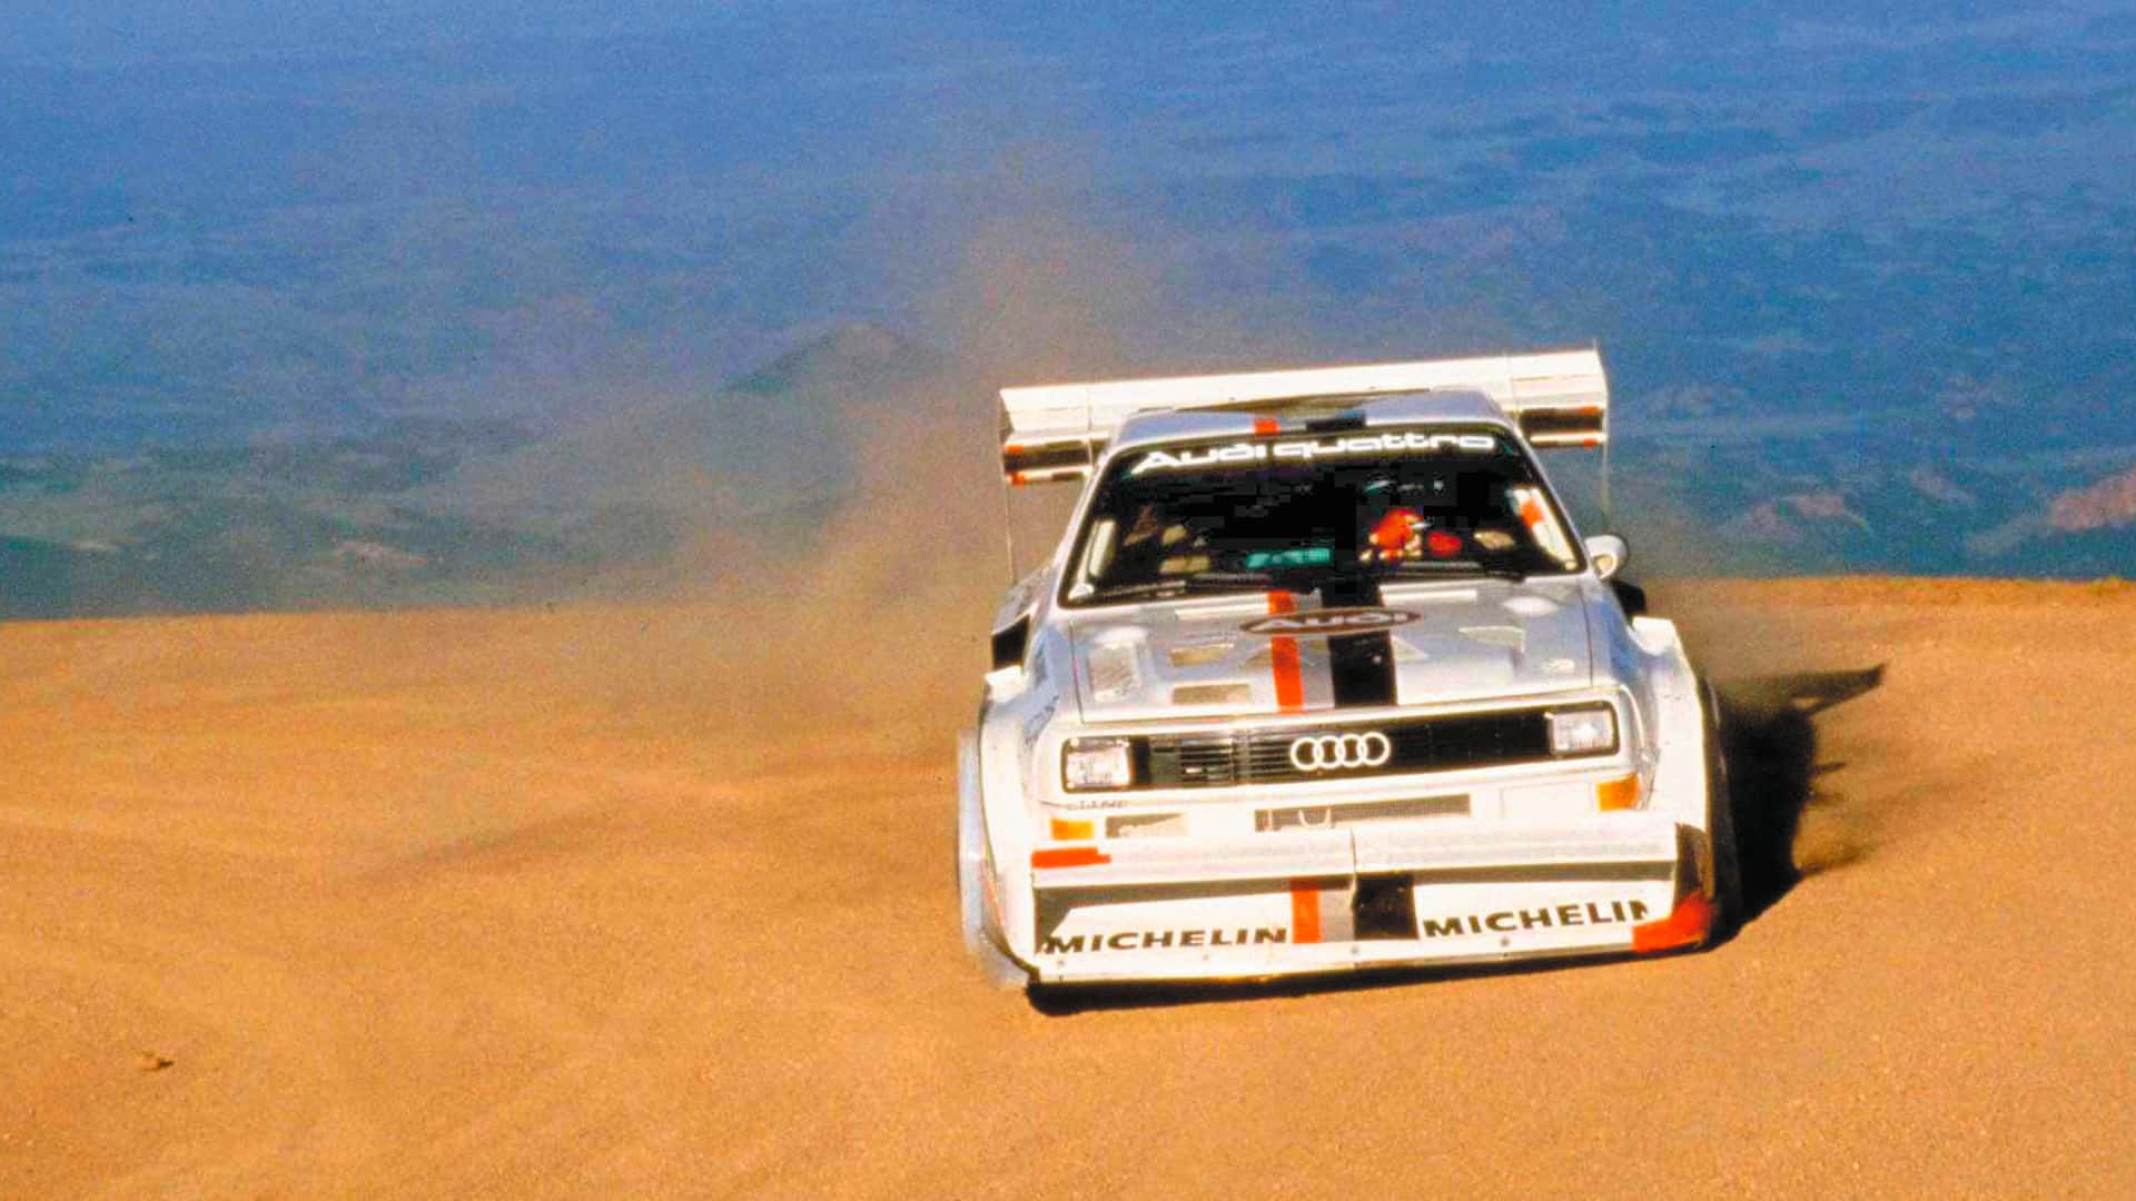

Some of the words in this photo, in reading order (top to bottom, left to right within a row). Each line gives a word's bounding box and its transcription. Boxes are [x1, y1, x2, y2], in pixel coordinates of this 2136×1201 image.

[1129, 443, 1268, 475] Audi
[1273, 433, 1495, 459] quattro
[1249, 611, 1408, 632] AUDI
[1043, 928, 1288, 954] MICHELIN
